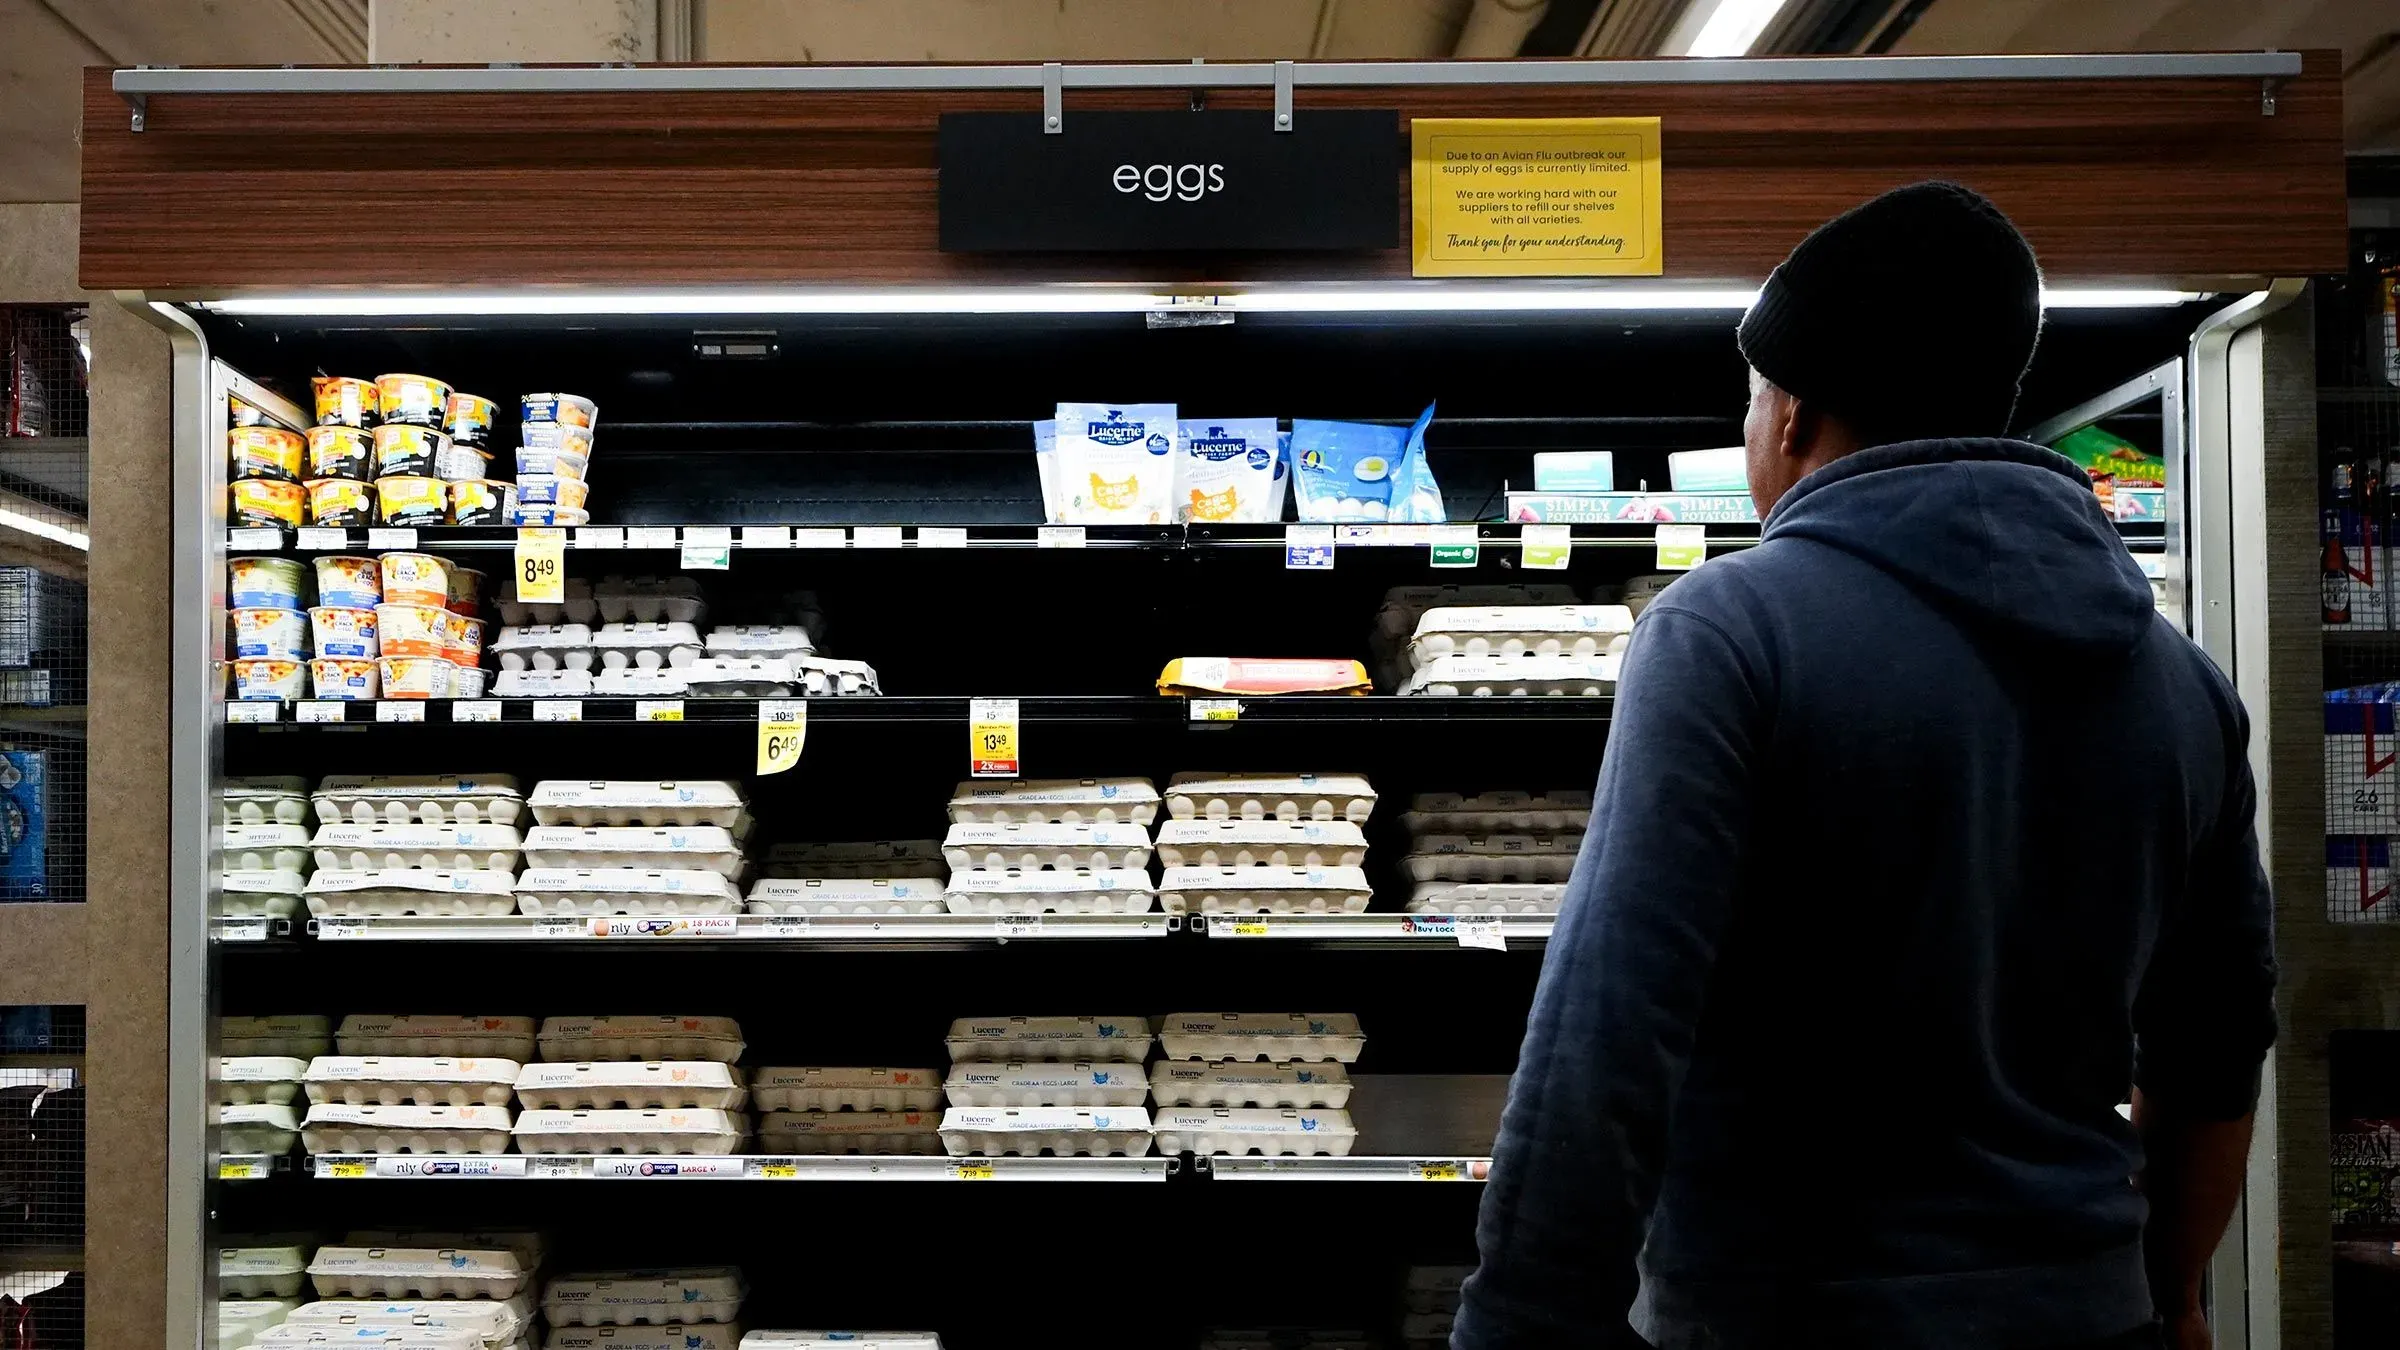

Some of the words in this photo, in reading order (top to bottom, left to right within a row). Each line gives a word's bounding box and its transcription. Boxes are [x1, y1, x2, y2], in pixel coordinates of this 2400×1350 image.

[1447, 151, 1468, 160] Due
[1471, 152, 1481, 160] to
[1502, 151, 1533, 160] Avian
[1536, 151, 1551, 160] Flu
[1554, 150, 1605, 159] outbreak
[1607, 151, 1626, 159] our
[1442, 163, 1479, 175] supply
[1482, 163, 1493, 173] of
[1495, 165, 1523, 175] eggs
[1525, 164, 1534, 173] is
[1537, 163, 1586, 174] currently
[1589, 163, 1631, 172] limited.
[1112, 161, 1225, 202] eggs
[1456, 190, 1473, 199] We
[1476, 191, 1494, 199] are
[1497, 189, 1541, 201] working
[1544, 189, 1570, 198] hard
[1573, 189, 1596, 198] with
[1598, 190, 1617, 198] our
[1459, 202, 1509, 214] suppliers
[1512, 203, 1523, 211] to
[1525, 202, 1549, 211] refill
[1573, 202, 1615, 211] shelves
[1490, 215, 1514, 224] with
[1516, 215, 1530, 224] all
[1532, 215, 1583, 224] varieties.
[1447, 234, 1480, 248] Thank
[1481, 240, 1501, 251] you
[1502, 234, 1517, 253] for
[1519, 239, 1543, 251] your
[1545, 235, 1626, 253] understanding.
[1091, 424, 1142, 437] Lucerne
[1193, 442, 1243, 452] Lucerne
[1197, 493, 1227, 509] Cage
[1680, 498, 1744, 511] SIMPLY
[1546, 499, 1612, 512] SIMPLY
[1202, 503, 1232, 517] Free
[1546, 512, 1612, 523] POTATOES
[1680, 511, 1746, 521] POTATOES
[1436, 550, 1461, 558] Organic
[525, 558, 554, 583] 849
[357, 573, 376, 582] CRACK
[1447, 616, 1481, 624] Lucerne
[651, 712, 667, 721] 469
[983, 734, 1007, 751] 1349
[768, 736, 798, 761] 649
[329, 782, 364, 790] Lucerne
[547, 790, 581, 798] Lucerne
[972, 789, 1006, 797] Lucerne
[2354, 789, 2379, 805] 2.6
[328, 832, 362, 840] Lucerne
[962, 830, 997, 838] Lucerne
[533, 877, 567, 885] Lucerne
[967, 878, 1001, 886] Lucerne
[767, 887, 800, 895] Lucerne
[692, 919, 703, 927] 18
[705, 919, 730, 927] PACK
[1417, 925, 1436, 933] Buy
[358, 1023, 392, 1031] Lucerne
[558, 1025, 592, 1033] Lucerne
[972, 1026, 1005, 1034] Lucerne
[1182, 1022, 1215, 1030] Lucerne
[1170, 1069, 1205, 1077] Lucerne
[772, 1076, 805, 1084] Lucerne
[965, 1073, 1000, 1082] Lucerne
[540, 1119, 574, 1127] Lucerne
[961, 1115, 996, 1123] Lucerne
[1174, 1117, 1208, 1125] Lucerne
[784, 1120, 817, 1128] Lucerne
[334, 1167, 349, 1176] 799
[463, 1167, 489, 1175] LARGE
[767, 1170, 780, 1178] 719
[962, 1170, 977, 1179] 739
[1425, 1170, 1441, 1180] 999
[323, 1258, 357, 1266] Lucerne
[557, 1290, 591, 1299] Lucerne
[560, 1338, 593, 1346] Lucerne
